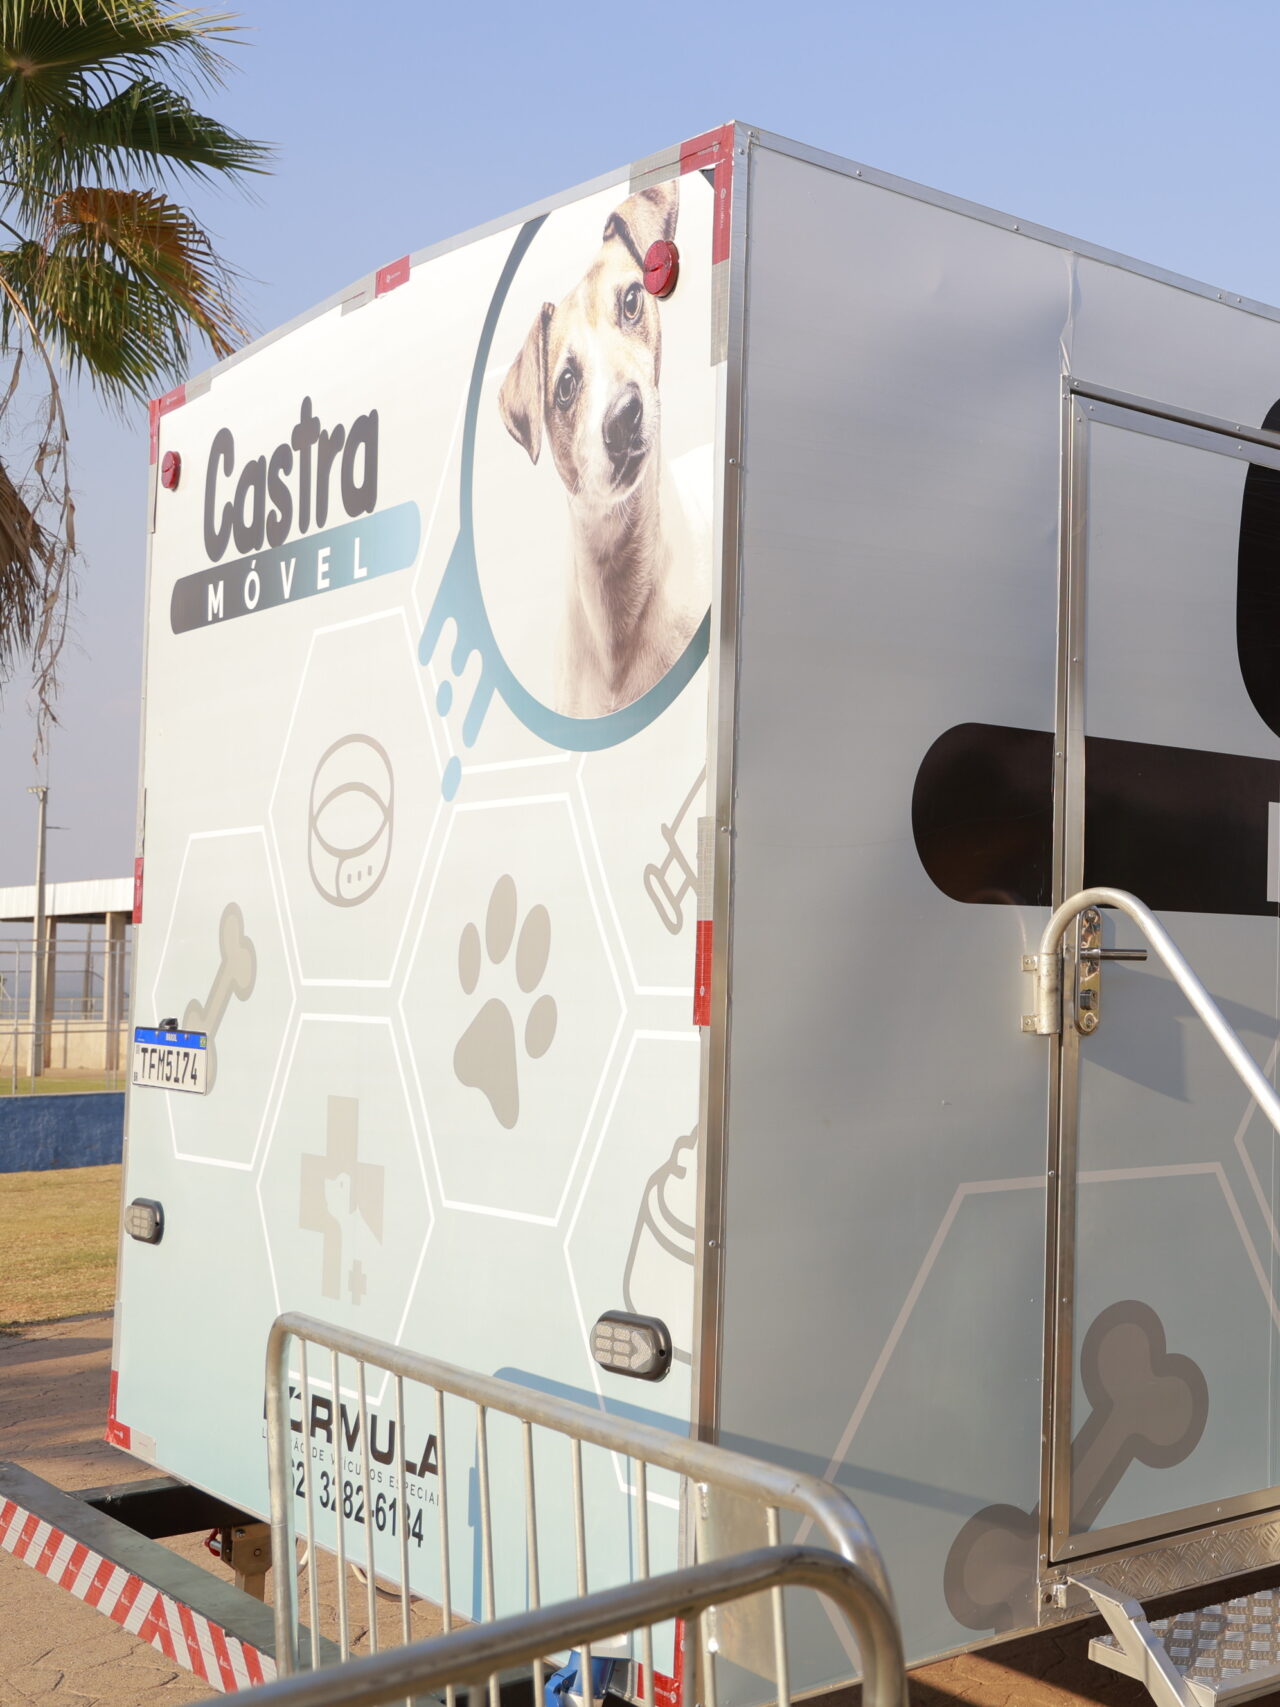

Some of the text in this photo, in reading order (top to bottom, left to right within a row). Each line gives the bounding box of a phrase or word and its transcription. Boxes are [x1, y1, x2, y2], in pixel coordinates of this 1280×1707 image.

[203, 396, 379, 563] Castra
[207, 537, 368, 622] MÓVEL
[263, 1383, 439, 1479] RMUA
[291, 1459, 306, 1499] 2
